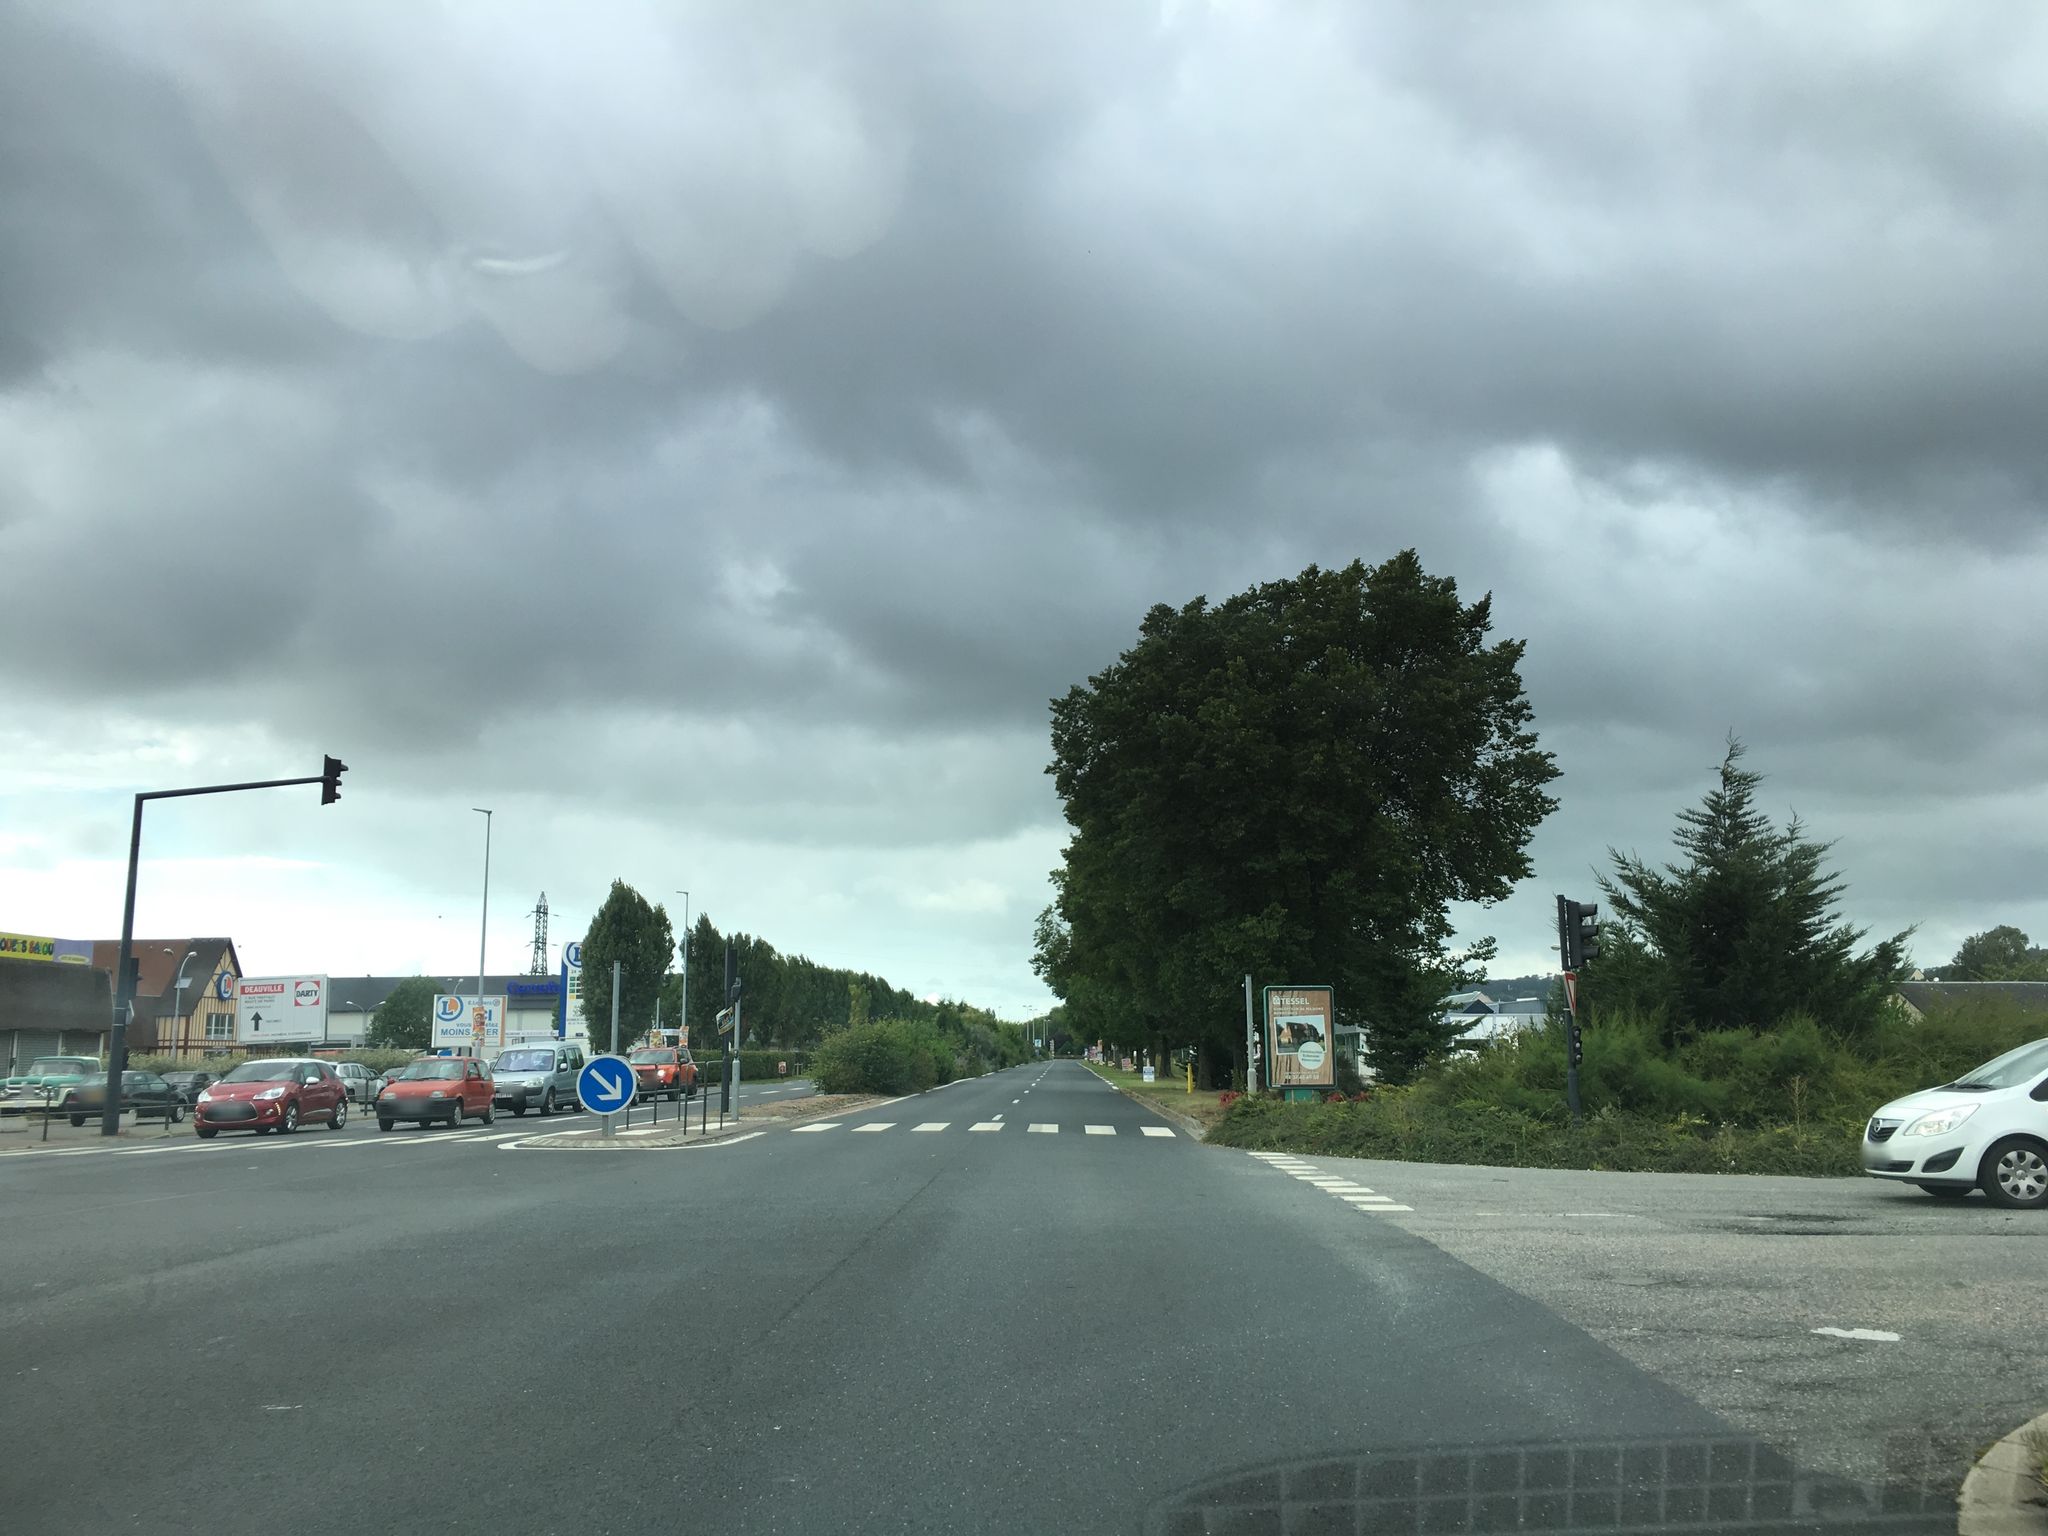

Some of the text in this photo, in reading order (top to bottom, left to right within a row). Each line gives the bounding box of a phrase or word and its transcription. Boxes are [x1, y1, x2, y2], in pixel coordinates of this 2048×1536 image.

[244, 985, 283, 994] DEAUVILLE
[296, 989, 319, 998] DARTY
[1281, 997, 1310, 1005] TESSEL
[440, 1028, 471, 1036] MOINS
[486, 1028, 499, 1036] ER
